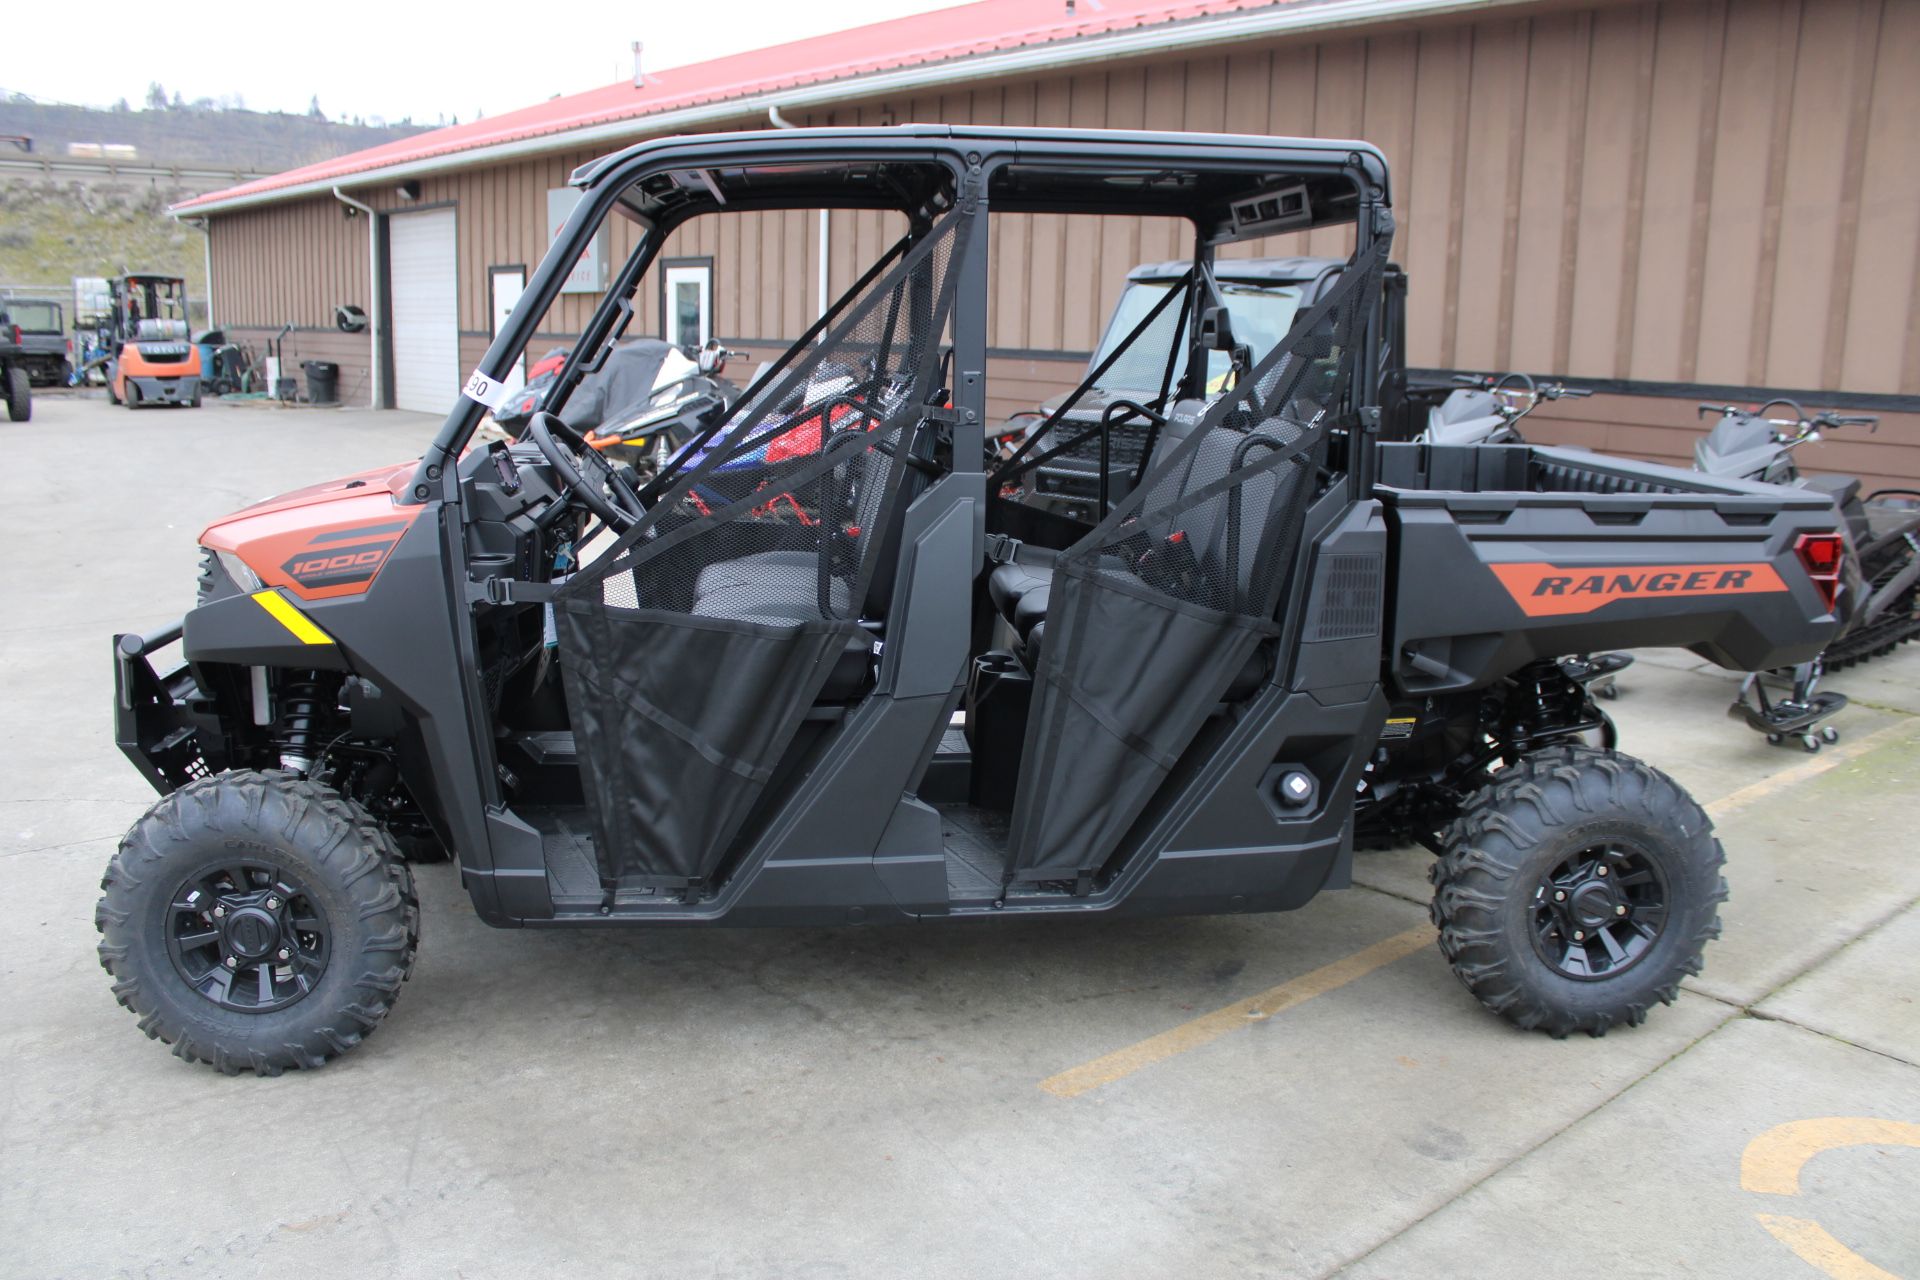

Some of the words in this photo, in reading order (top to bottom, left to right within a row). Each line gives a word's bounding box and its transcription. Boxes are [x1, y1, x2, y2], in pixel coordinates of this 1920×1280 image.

[145, 344, 187, 354] TOYOTA
[1173, 413, 1196, 426] POLARIS
[291, 550, 384, 575] 1000
[1531, 570, 1753, 596] RANGER
